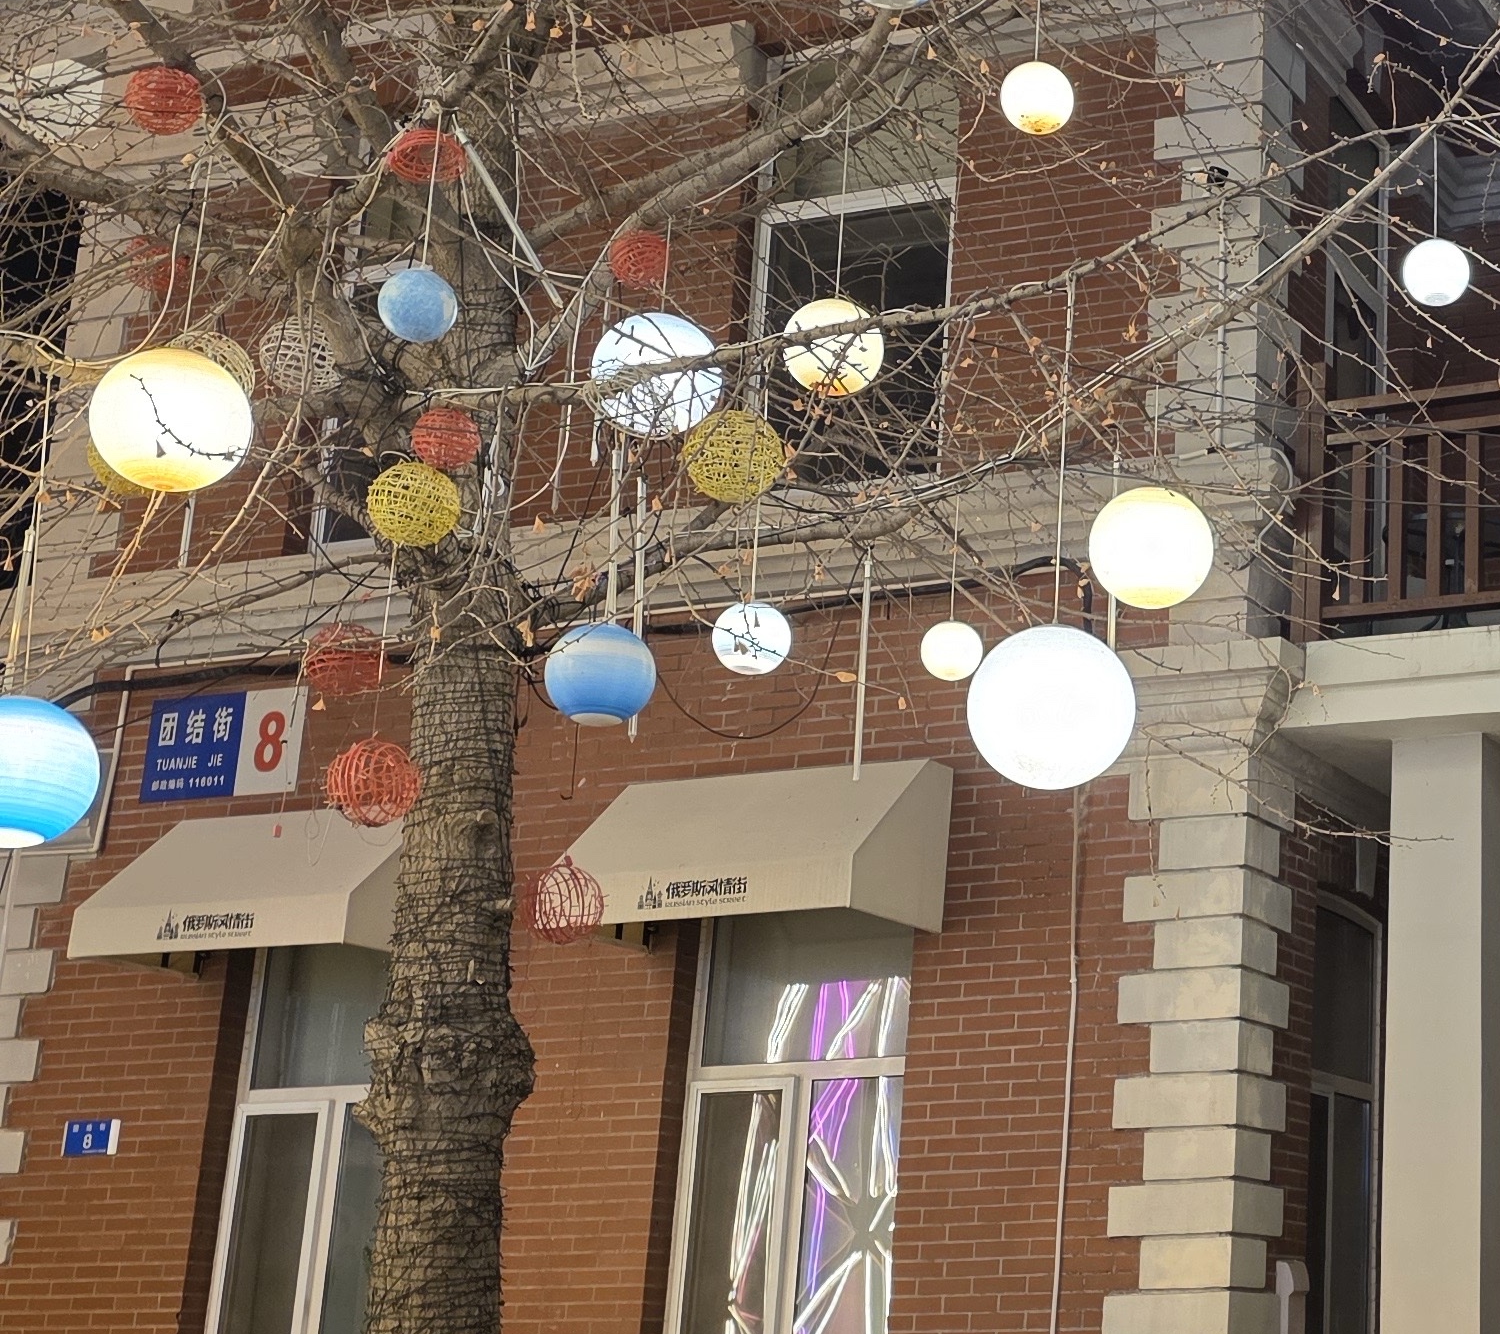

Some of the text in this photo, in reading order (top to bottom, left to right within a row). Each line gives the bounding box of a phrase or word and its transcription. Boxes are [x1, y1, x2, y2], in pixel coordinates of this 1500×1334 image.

[158, 706, 234, 747] 团结街
[253, 711, 286, 772] 8
[156, 753, 224, 772] TUANJIE JIE
[188, 775, 225, 788] 116011
[665, 876, 747, 900] 俄罗斯风情街
[182, 913, 254, 932] 俄罗斯风情街
[82, 1133, 93, 1149] 8
